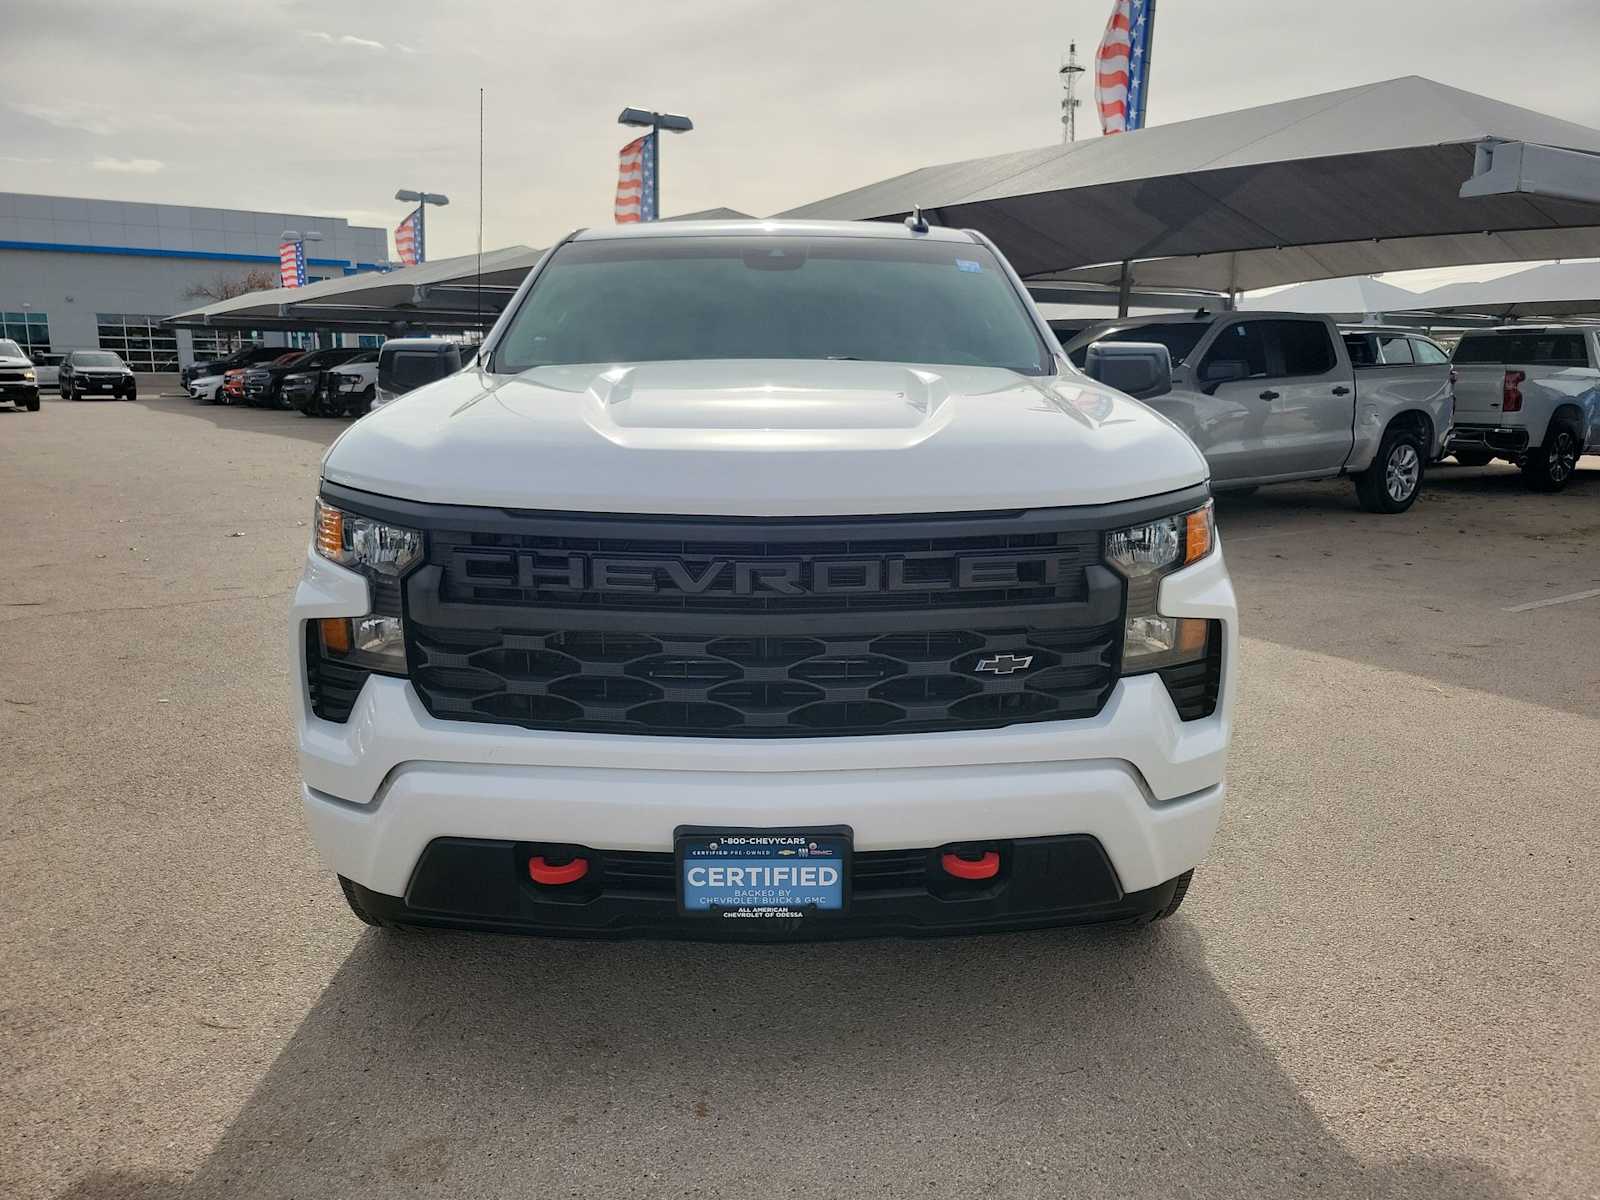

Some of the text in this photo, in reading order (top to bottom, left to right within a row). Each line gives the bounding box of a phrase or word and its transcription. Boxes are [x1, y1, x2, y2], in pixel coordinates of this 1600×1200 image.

[450, 549, 1080, 594] CHEVROLET
[720, 837, 806, 845] 1-800-CHEVYCARS
[687, 866, 838, 887] CERTIFIED
[734, 889, 792, 897] BACKED BY
[804, 896, 826, 904] GMC
